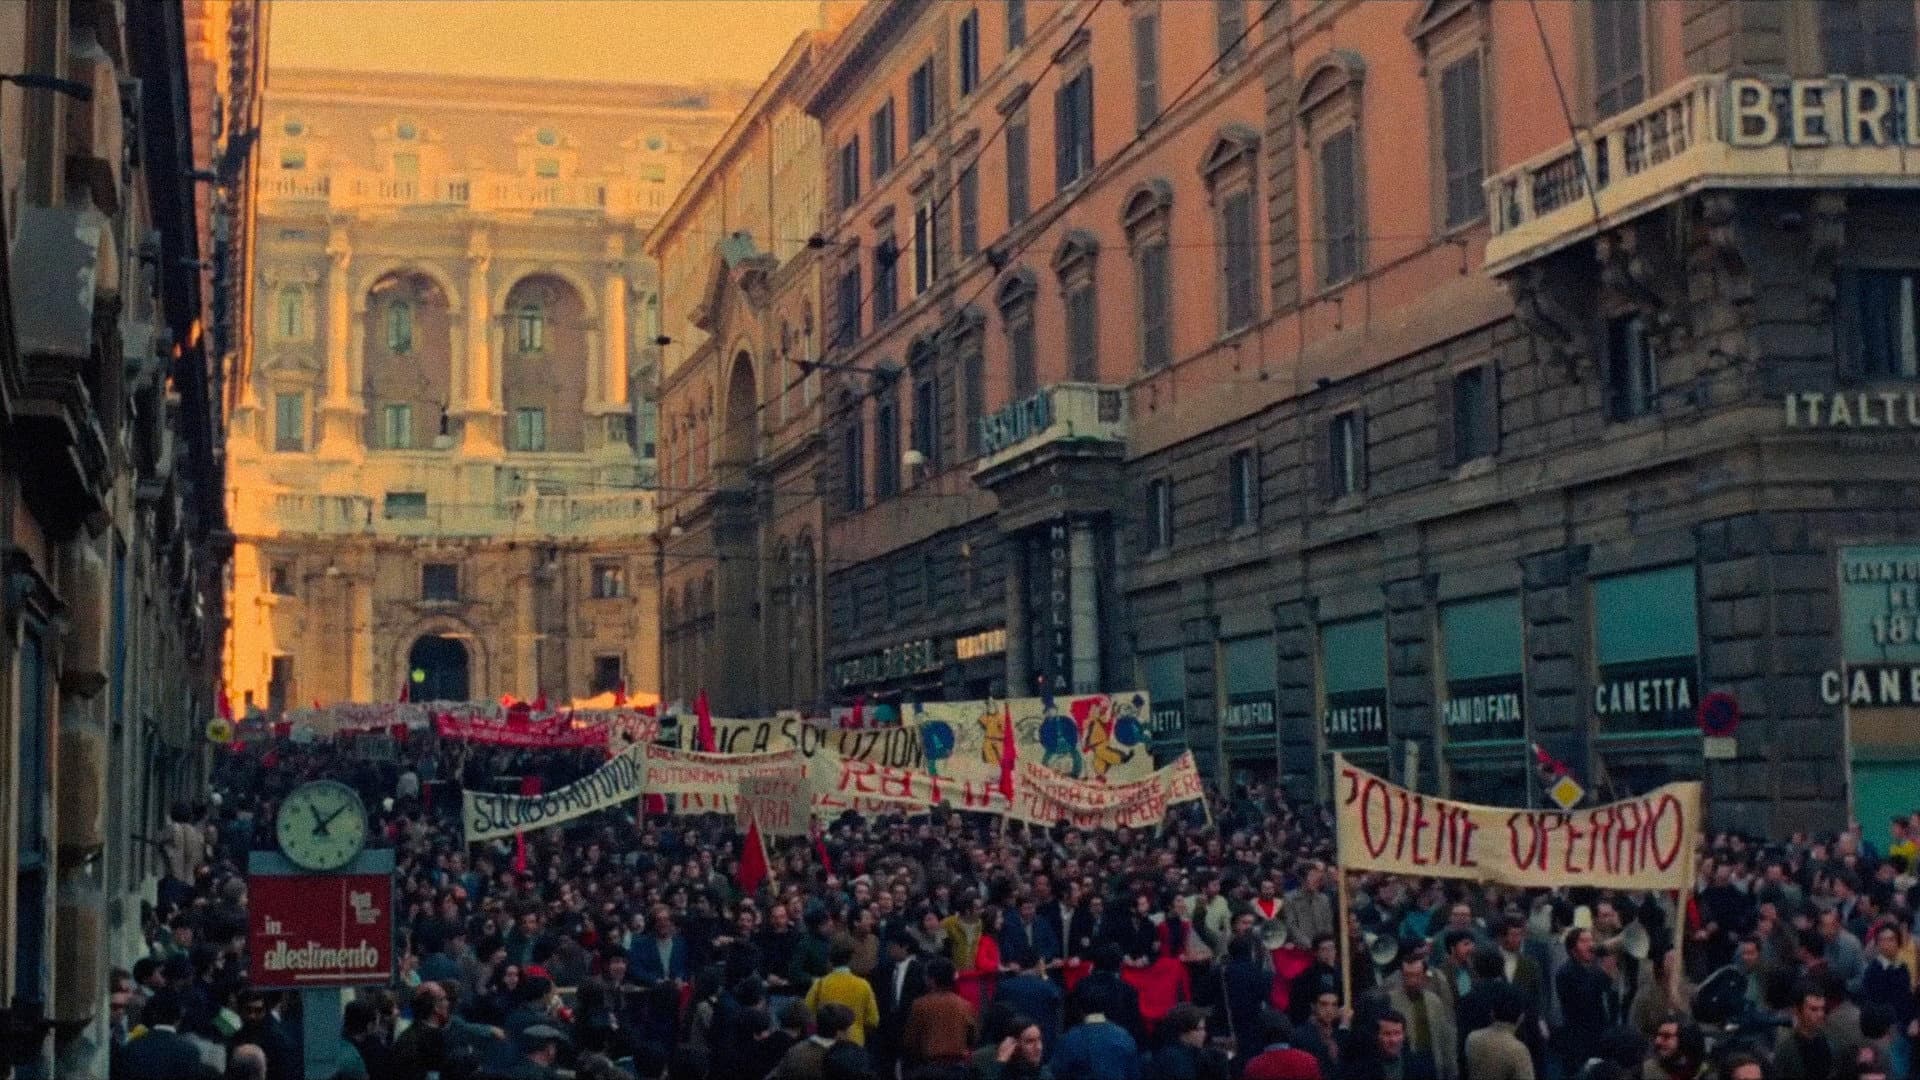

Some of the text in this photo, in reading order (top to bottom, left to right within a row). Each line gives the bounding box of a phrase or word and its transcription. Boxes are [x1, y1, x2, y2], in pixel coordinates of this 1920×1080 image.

[1872, 613, 1920, 644] 18
[1595, 676, 1692, 714] CANETTA
[1323, 705, 1383, 734] CANETTA
[1506, 793, 1684, 875] OPERAIO
[264, 915, 282, 935] in
[263, 939, 379, 971] allestimento
